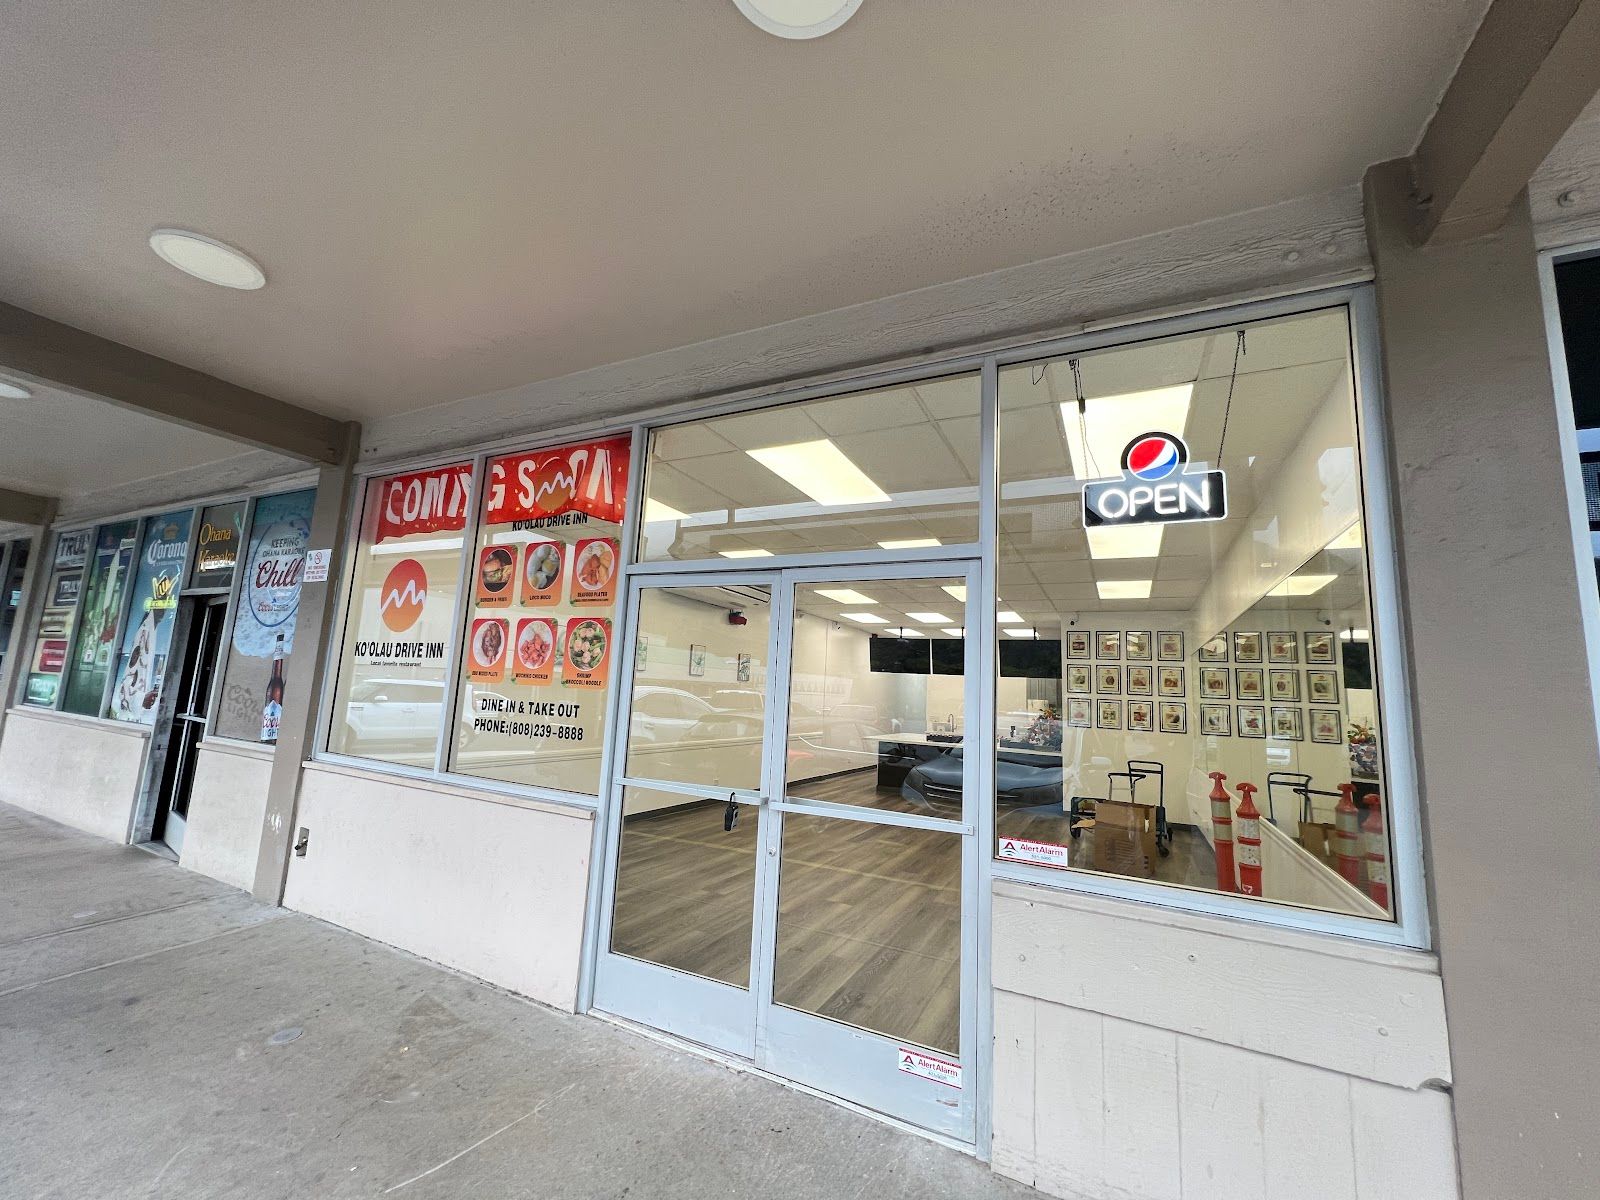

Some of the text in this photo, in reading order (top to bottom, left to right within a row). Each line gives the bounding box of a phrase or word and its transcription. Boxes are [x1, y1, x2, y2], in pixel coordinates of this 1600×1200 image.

[518, 449, 614, 509] SON
[1098, 479, 1211, 519] OPEN
[512, 513, 588, 531] KO'OLAU DRIVE INN
[200, 523, 232, 545] Ohana
[271, 537, 300, 549] KEEPING
[147, 539, 188, 565] Corona
[198, 549, 236, 570] Karaoke
[256, 557, 304, 588] Chill
[354, 641, 445, 659] KO'OLAU DRIVE INN
[481, 698, 580, 719] DINE IN & TAKE OUT
[474, 718, 584, 741] PHONE:(808)239-8888
